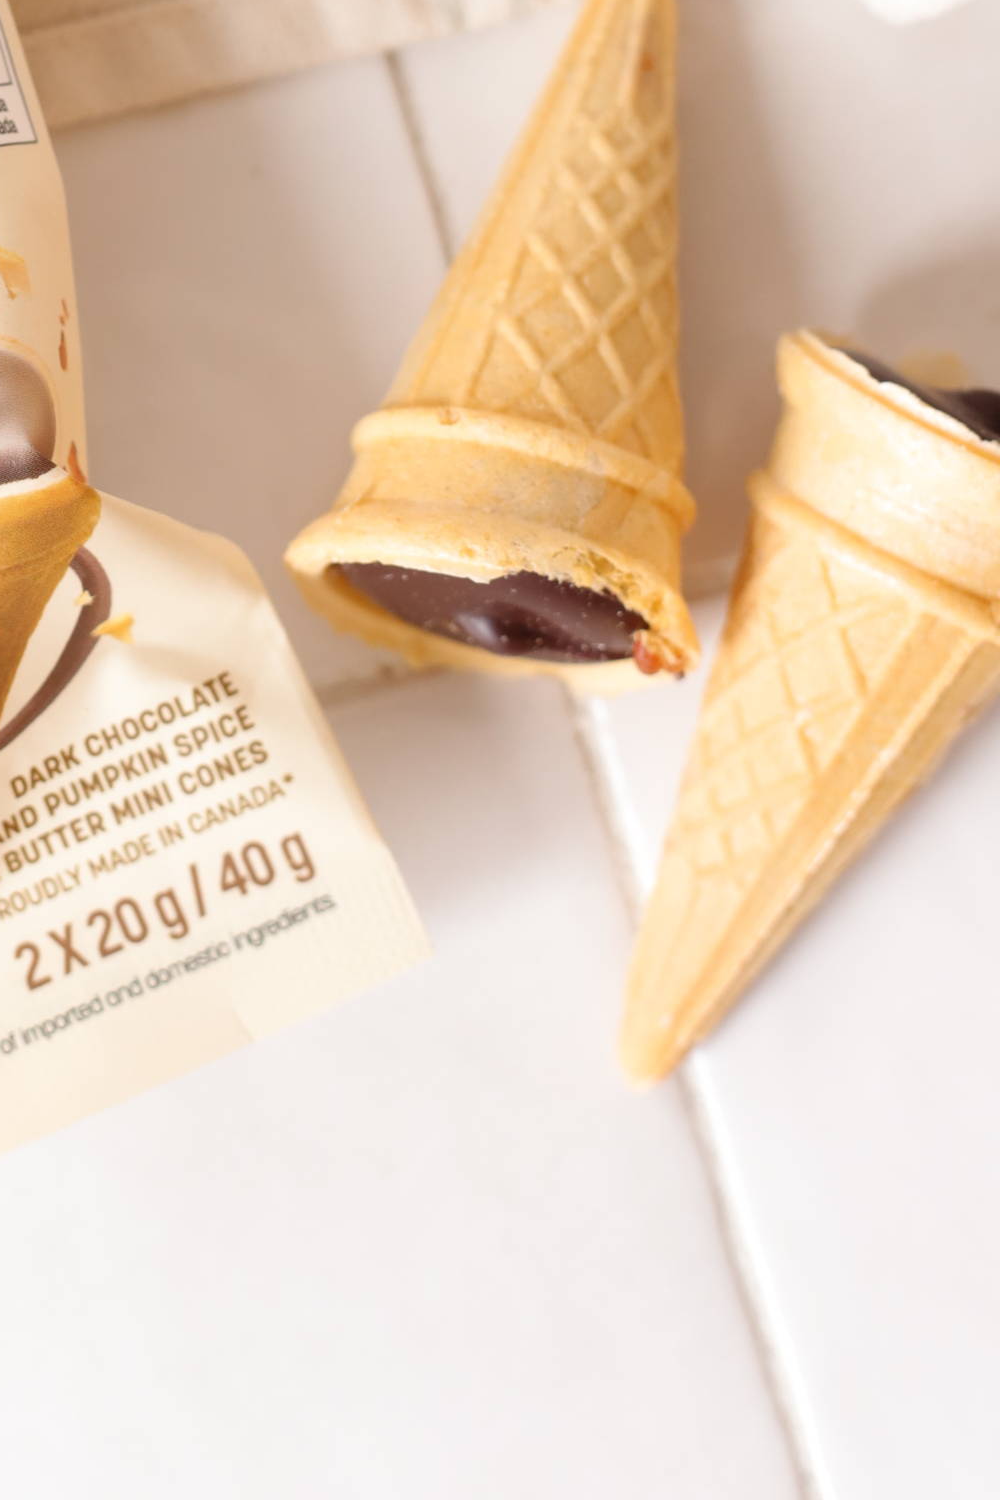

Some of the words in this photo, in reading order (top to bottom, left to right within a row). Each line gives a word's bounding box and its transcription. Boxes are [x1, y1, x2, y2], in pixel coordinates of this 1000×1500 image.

[10, 744, 81, 798] DARK
[84, 671, 239, 757] CHOCOLATE
[43, 743, 169, 816] PUMPKIN
[173, 705, 255, 757] SPICE
[4, 811, 106, 873] BUTTER
[110, 780, 173, 824] MINI
[178, 740, 268, 795] CONES
[88, 833, 155, 879] MADE
[157, 821, 184, 848] IN
[0, 1031, 20, 1055] of
[22, 996, 104, 1045] imported
[105, 977, 144, 1007] and
[145, 937, 232, 990] domestic
